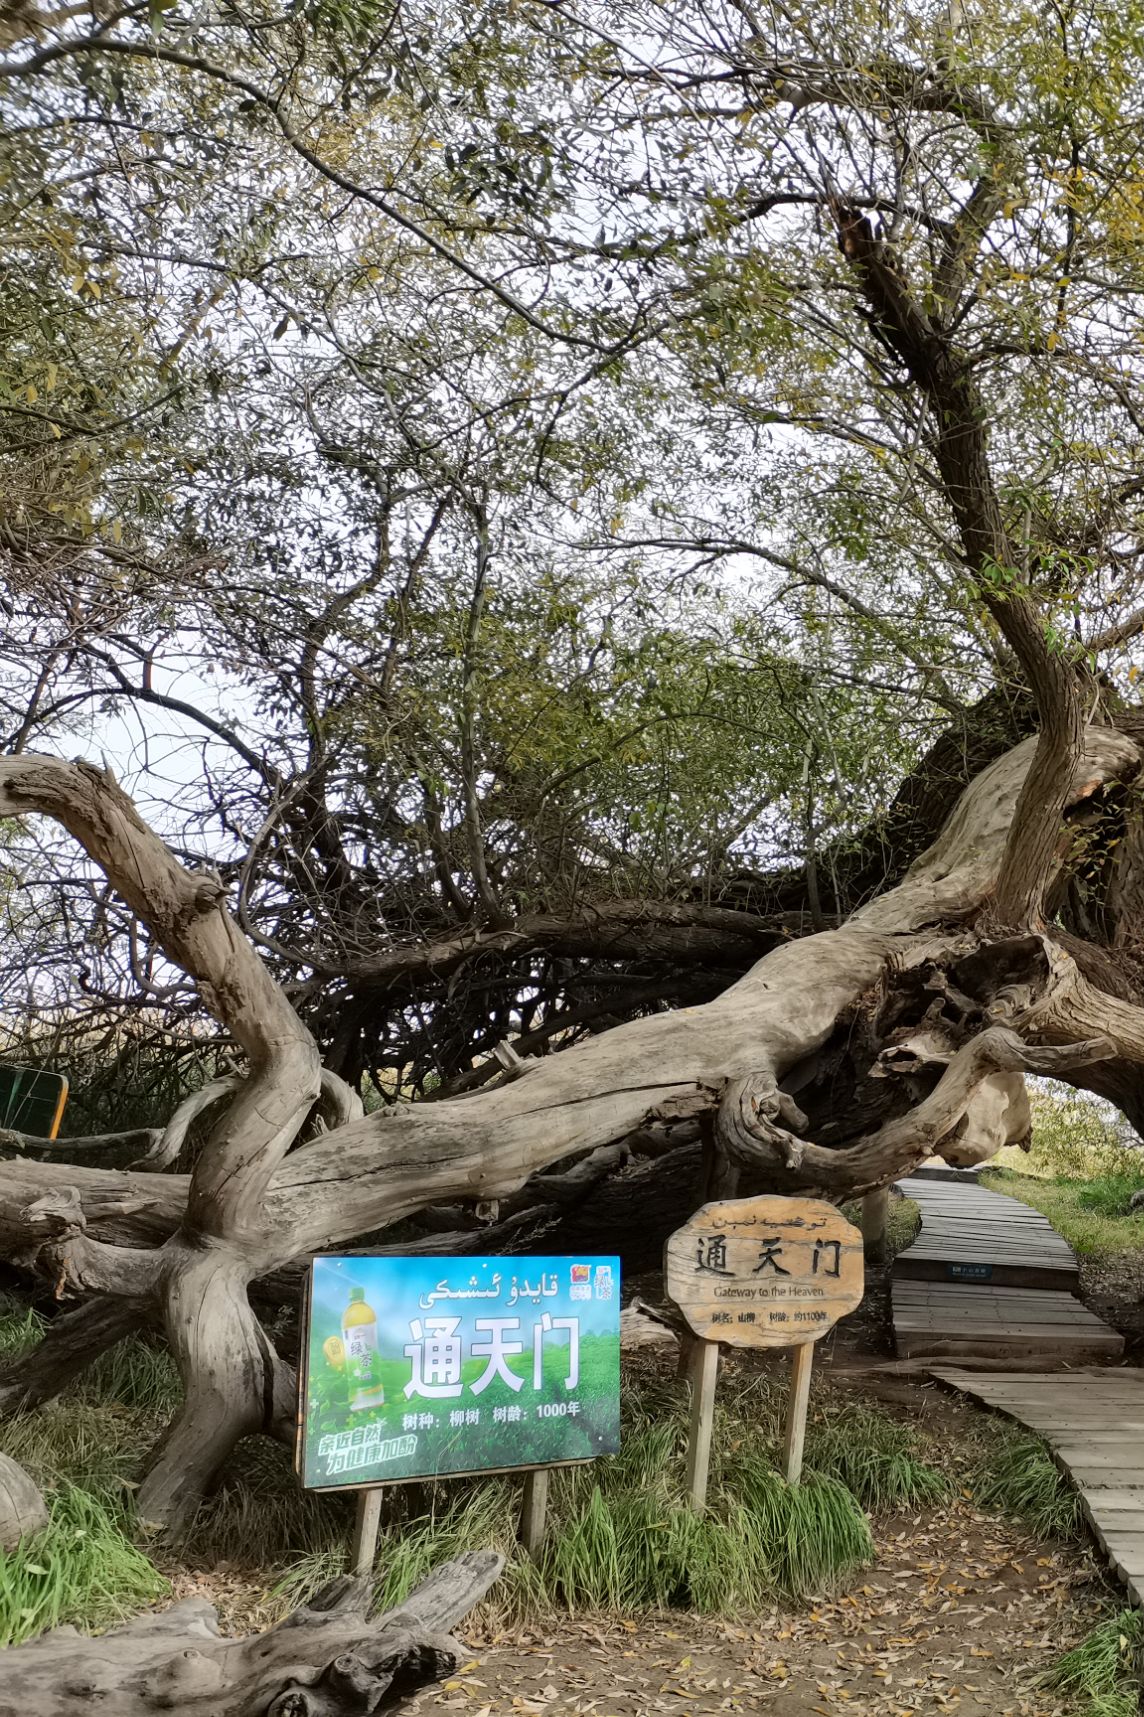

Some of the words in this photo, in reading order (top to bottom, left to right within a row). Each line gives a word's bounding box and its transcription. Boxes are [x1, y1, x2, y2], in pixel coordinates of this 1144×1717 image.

[695, 1234, 841, 1278] 通天门
[714, 1286, 756, 1300] Gateway
[759, 1287, 769, 1297] to
[771, 1285, 786, 1297] the
[789, 1286, 825, 1297] Heaven
[403, 1311, 580, 1400] 通天门
[318, 1422, 382, 1456] 亲近自然
